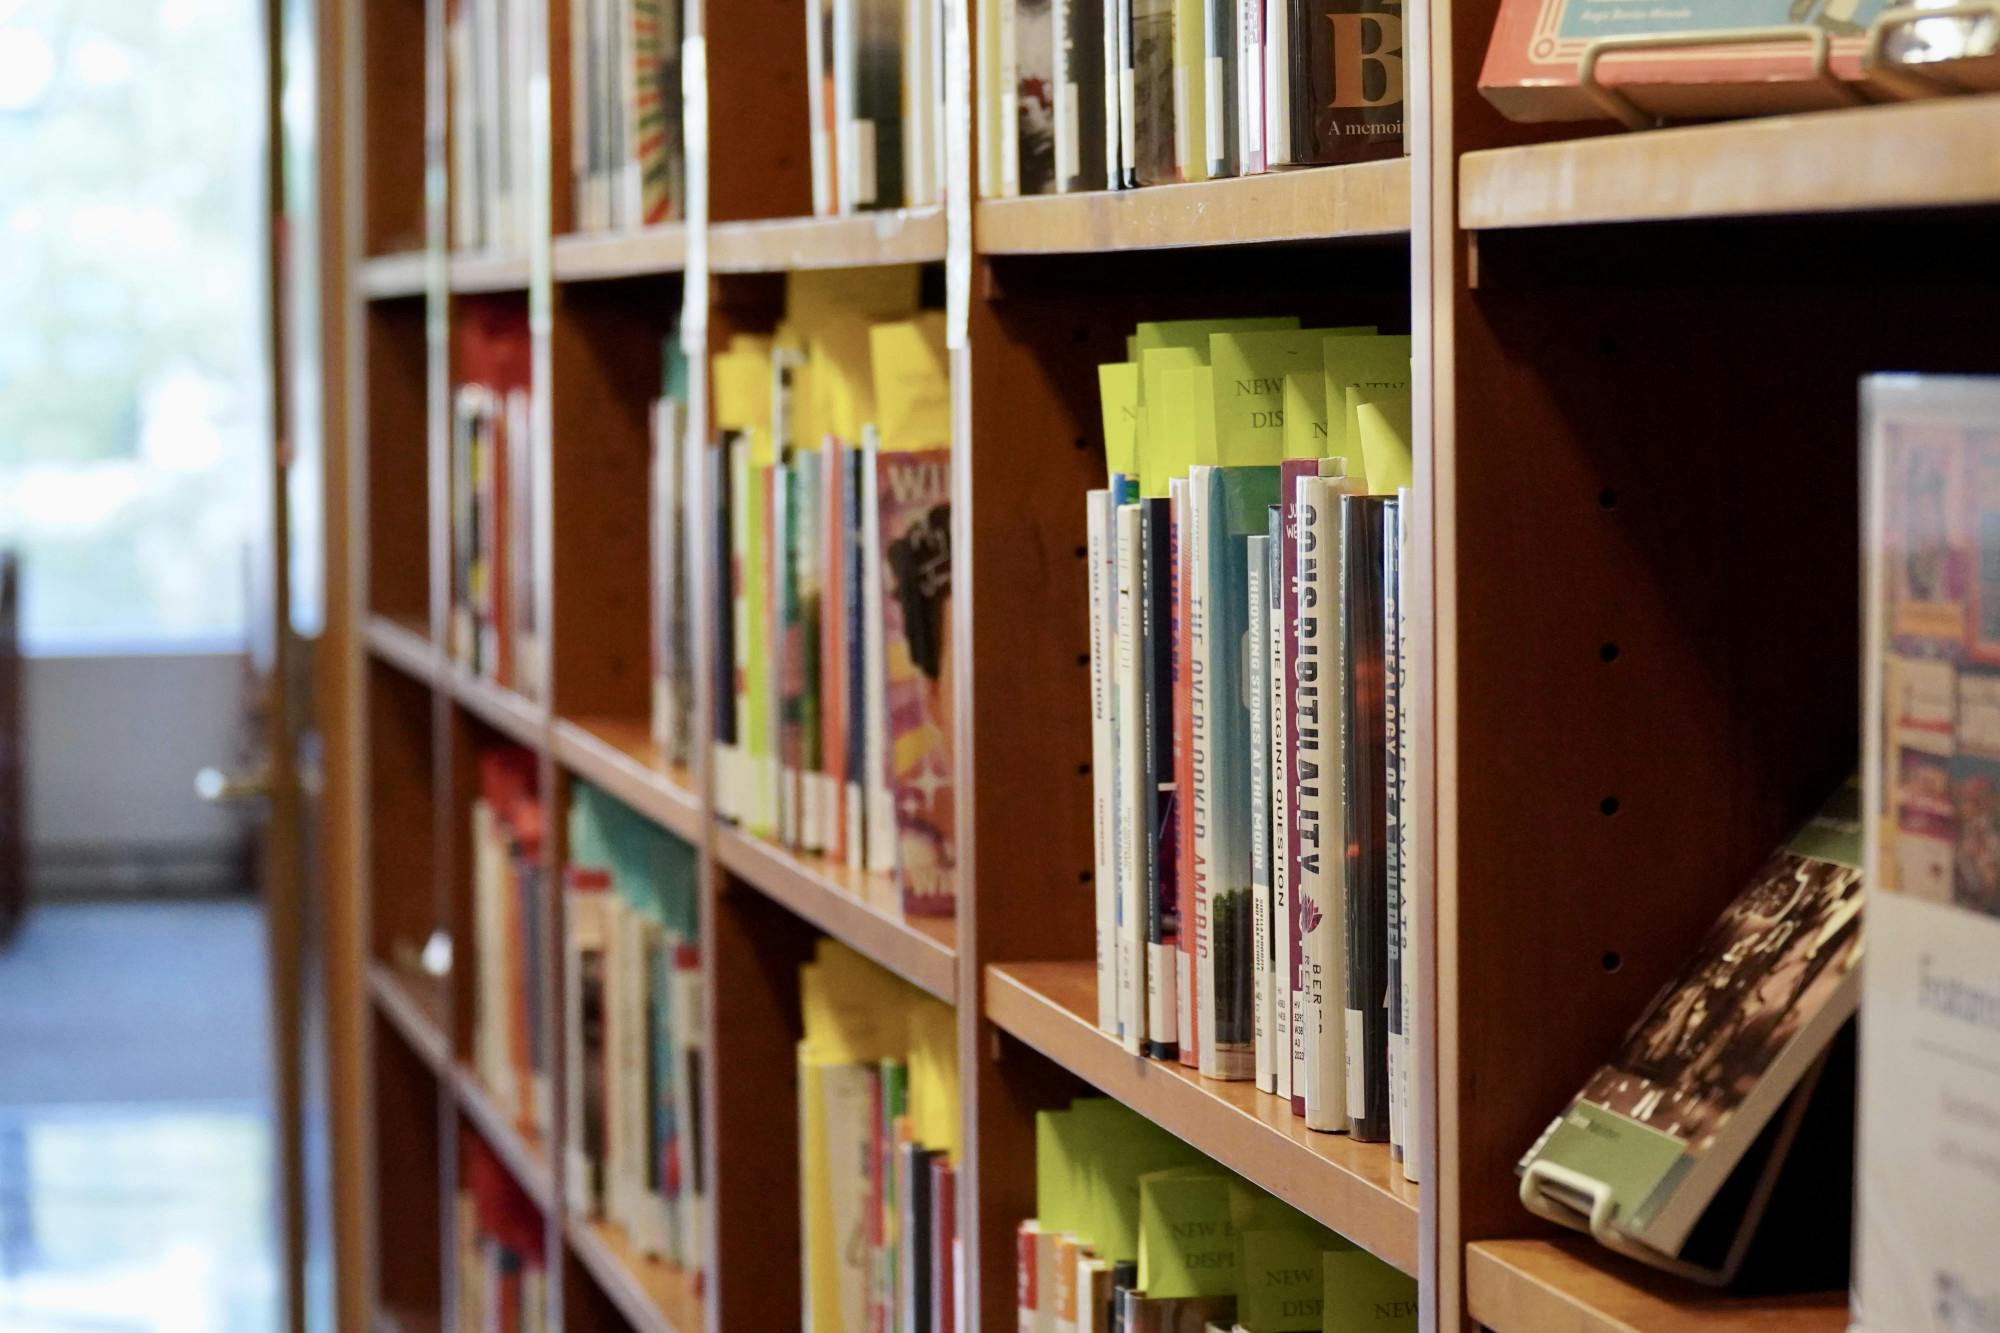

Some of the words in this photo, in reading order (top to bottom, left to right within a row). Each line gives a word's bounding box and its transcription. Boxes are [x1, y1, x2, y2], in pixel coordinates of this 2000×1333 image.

[1328, 120, 1341, 136] A
[1236, 378, 1284, 396] NEW
[1251, 410, 1284, 428] DIS
[1286, 524, 1298, 540] WE
[1191, 596, 1203, 645] THE
[1250, 569, 1262, 670] THROWING
[1385, 597, 1396, 755] GENEALOGY
[1251, 675, 1262, 744] STONES
[1192, 660, 1206, 839] OVERLOOKED
[1252, 749, 1263, 769] AT
[1252, 775, 1263, 809] THE
[1386, 767, 1397, 800] OF
[1387, 812, 1398, 827] A
[1253, 812, 1264, 870] MOON
[1276, 789, 1285, 908] QUESTION
[1194, 854, 1208, 960] AMERIC
[1387, 841, 1399, 960] MURDER
[1172, 1222, 1215, 1238] NEW
[1186, 1252, 1235, 1270] DISPL
[1265, 1269, 1314, 1286] NEW
[1283, 1301, 1323, 1317] DIS
